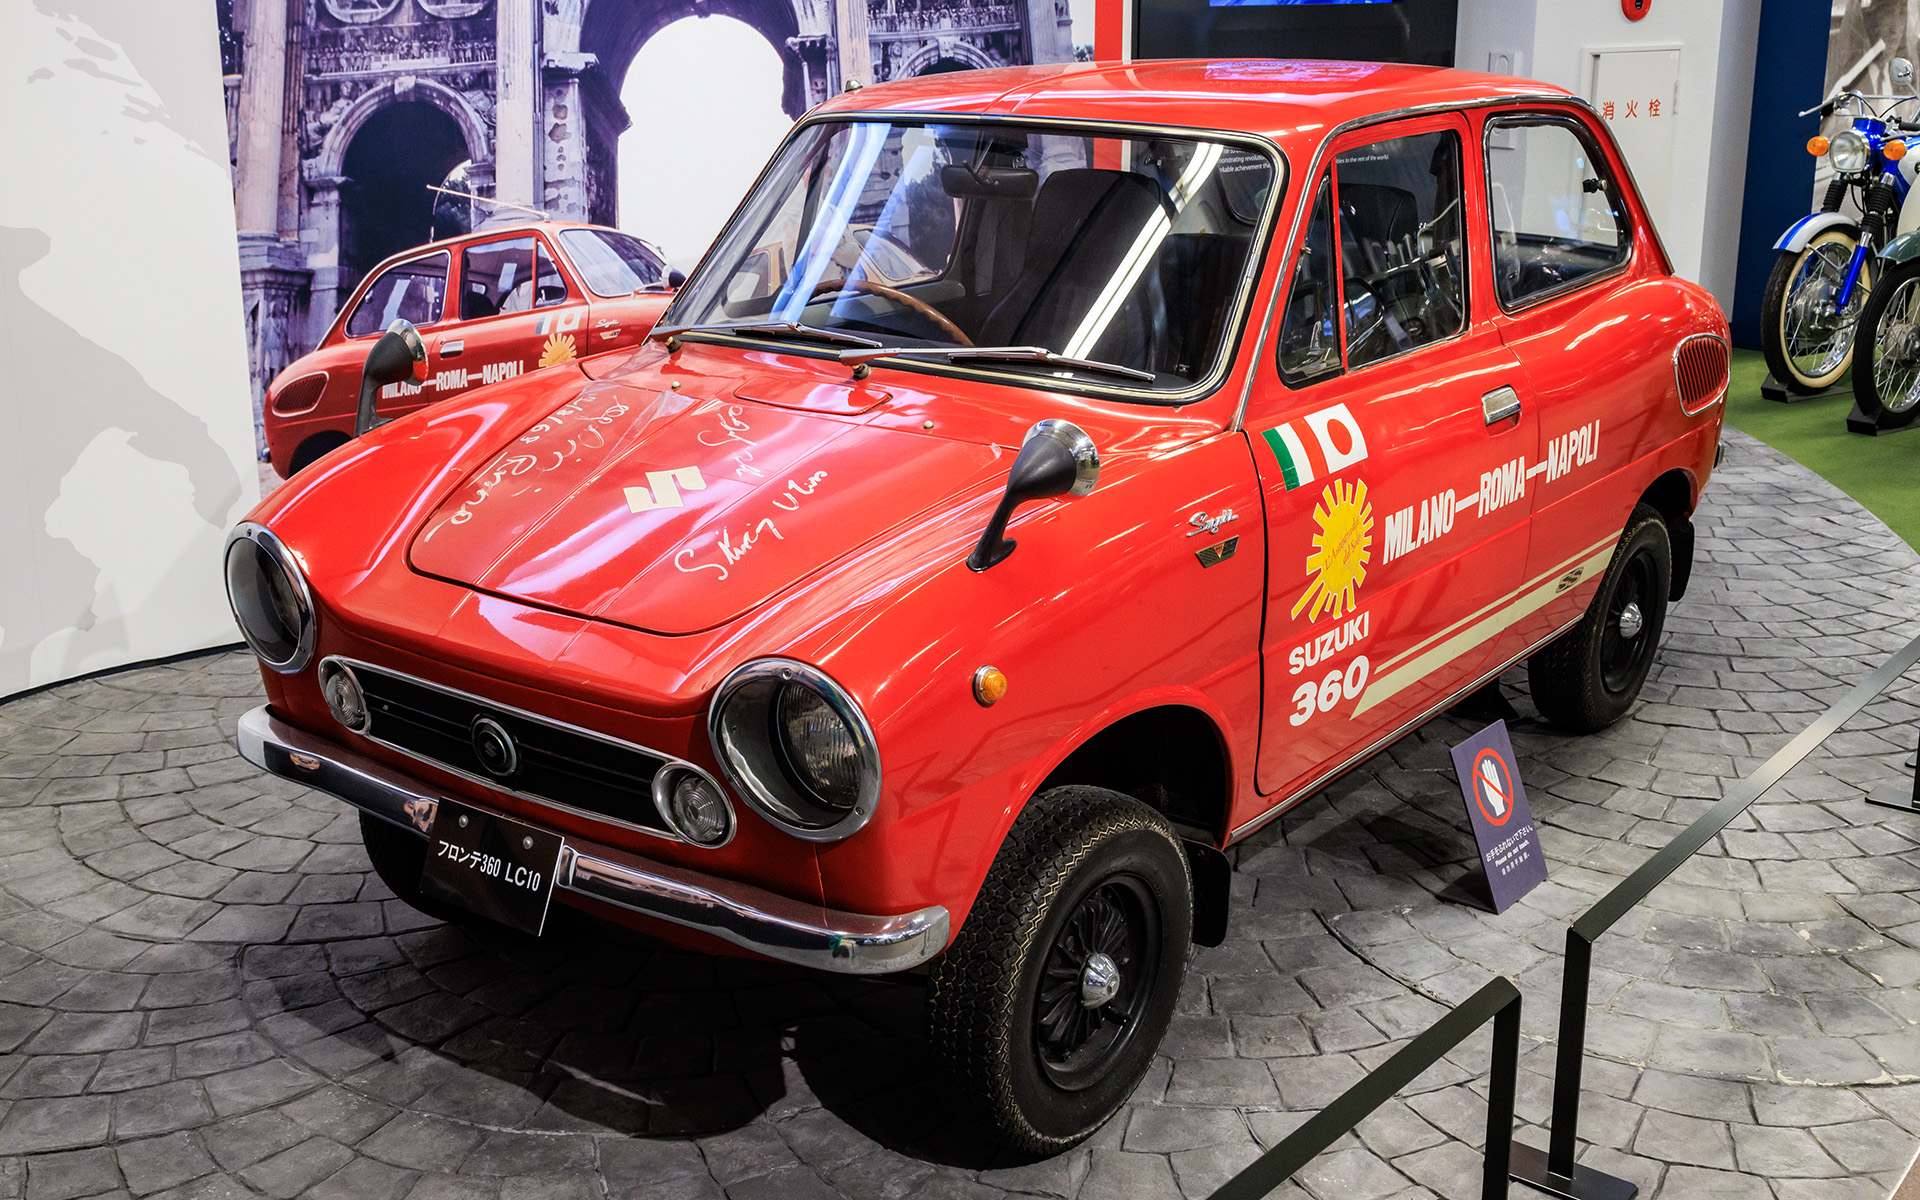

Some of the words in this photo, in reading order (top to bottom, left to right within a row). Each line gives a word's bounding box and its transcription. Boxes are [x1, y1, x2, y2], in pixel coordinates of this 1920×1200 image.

[1602, 98, 1662, 121] 消火栓
[1288, 610, 1370, 675] SUZUKI
[1289, 655, 1370, 727] 360
[437, 840, 501, 877] フロンテ360
[504, 862, 541, 892] LC10
